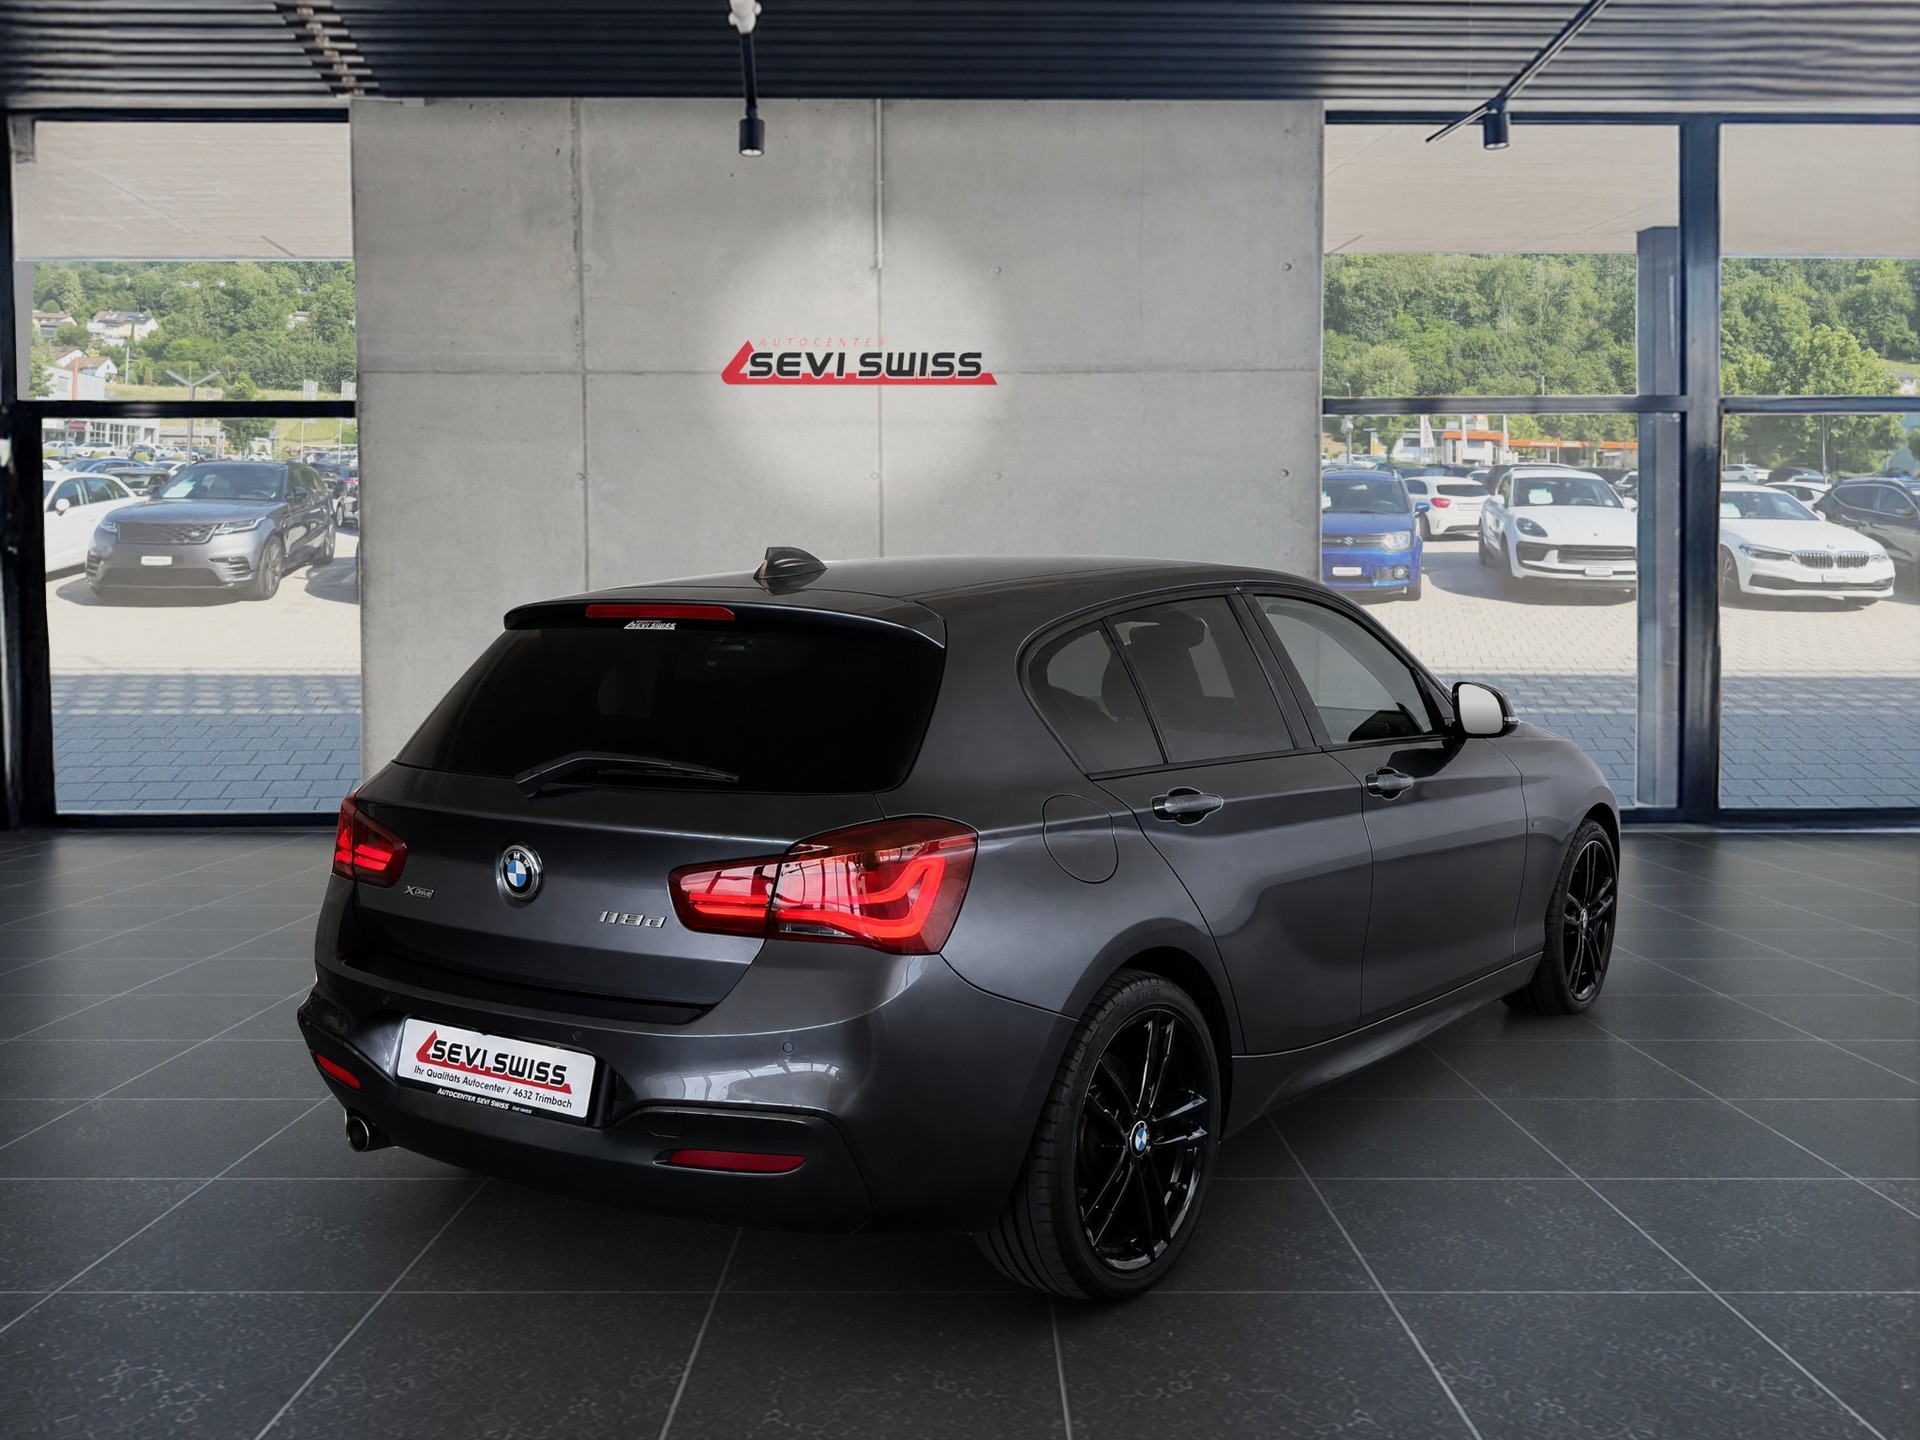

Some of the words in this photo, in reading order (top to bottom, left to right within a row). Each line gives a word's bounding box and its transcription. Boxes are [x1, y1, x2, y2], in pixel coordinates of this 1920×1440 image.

[758, 337, 886, 347] AUTOCENTER
[749, 352, 846, 377] SEVI
[858, 352, 983, 377] SWISS
[599, 910, 667, 928] 118d
[431, 1039, 488, 1070] SEVI
[492, 1053, 567, 1086] SWISS
[413, 1065, 425, 1075] Ihr
[426, 1068, 461, 1084] Qualitäts
[461, 1076, 506, 1094] Autocenter
[512, 1088, 533, 1100] 4632
[535, 1092, 573, 1109] Trimbach
[436, 1088, 476, 1103] AUTOCENTER
[476, 1097, 491, 1106] SEVI
[490, 1100, 510, 1110] SWISS
